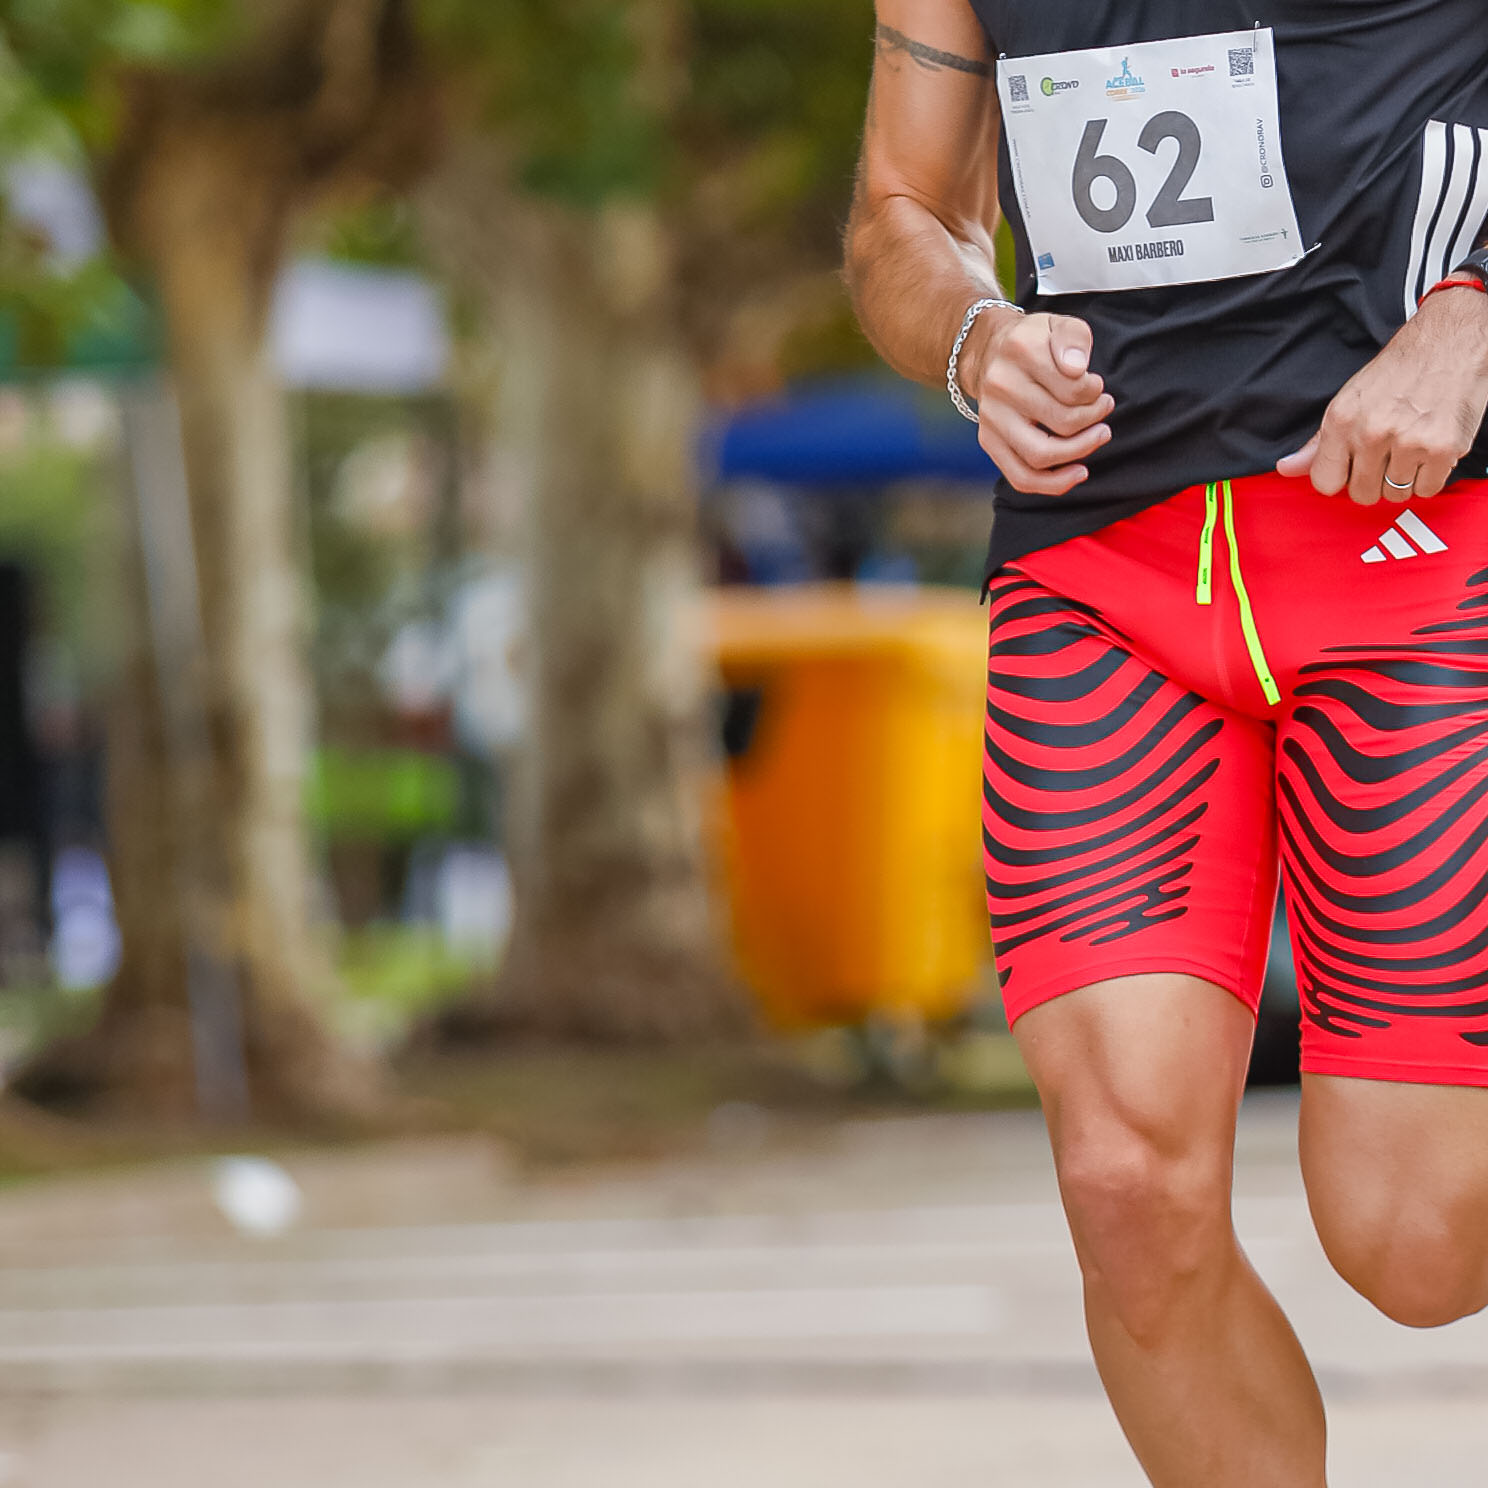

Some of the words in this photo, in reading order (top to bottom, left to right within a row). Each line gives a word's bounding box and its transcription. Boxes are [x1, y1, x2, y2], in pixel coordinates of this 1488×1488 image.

[1072, 110, 1214, 233] 62
[1108, 244, 1134, 263] MAXI
[1136, 239, 1184, 261] BARBERO
